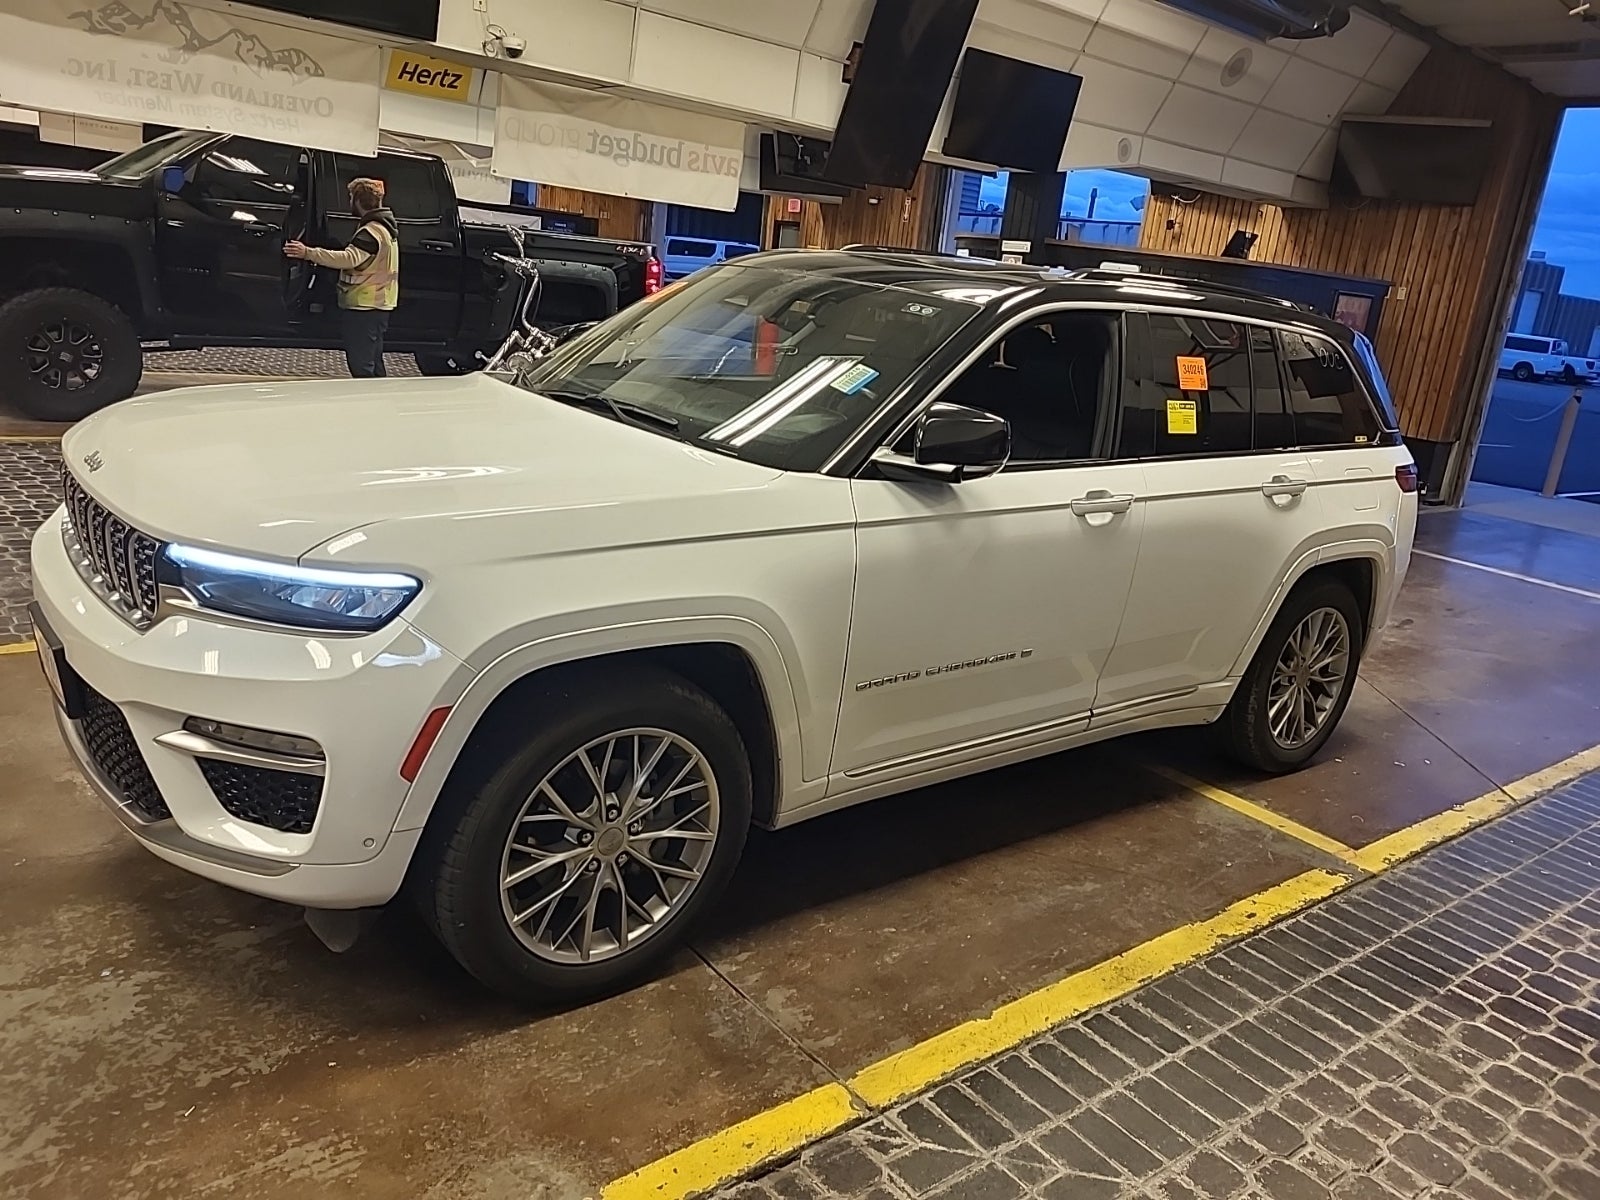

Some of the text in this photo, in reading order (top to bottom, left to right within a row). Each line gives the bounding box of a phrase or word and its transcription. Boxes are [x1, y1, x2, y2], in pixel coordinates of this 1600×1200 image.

[397, 61, 464, 90] Hertz
[855, 651, 1017, 692] GRAND CHEROKEE
